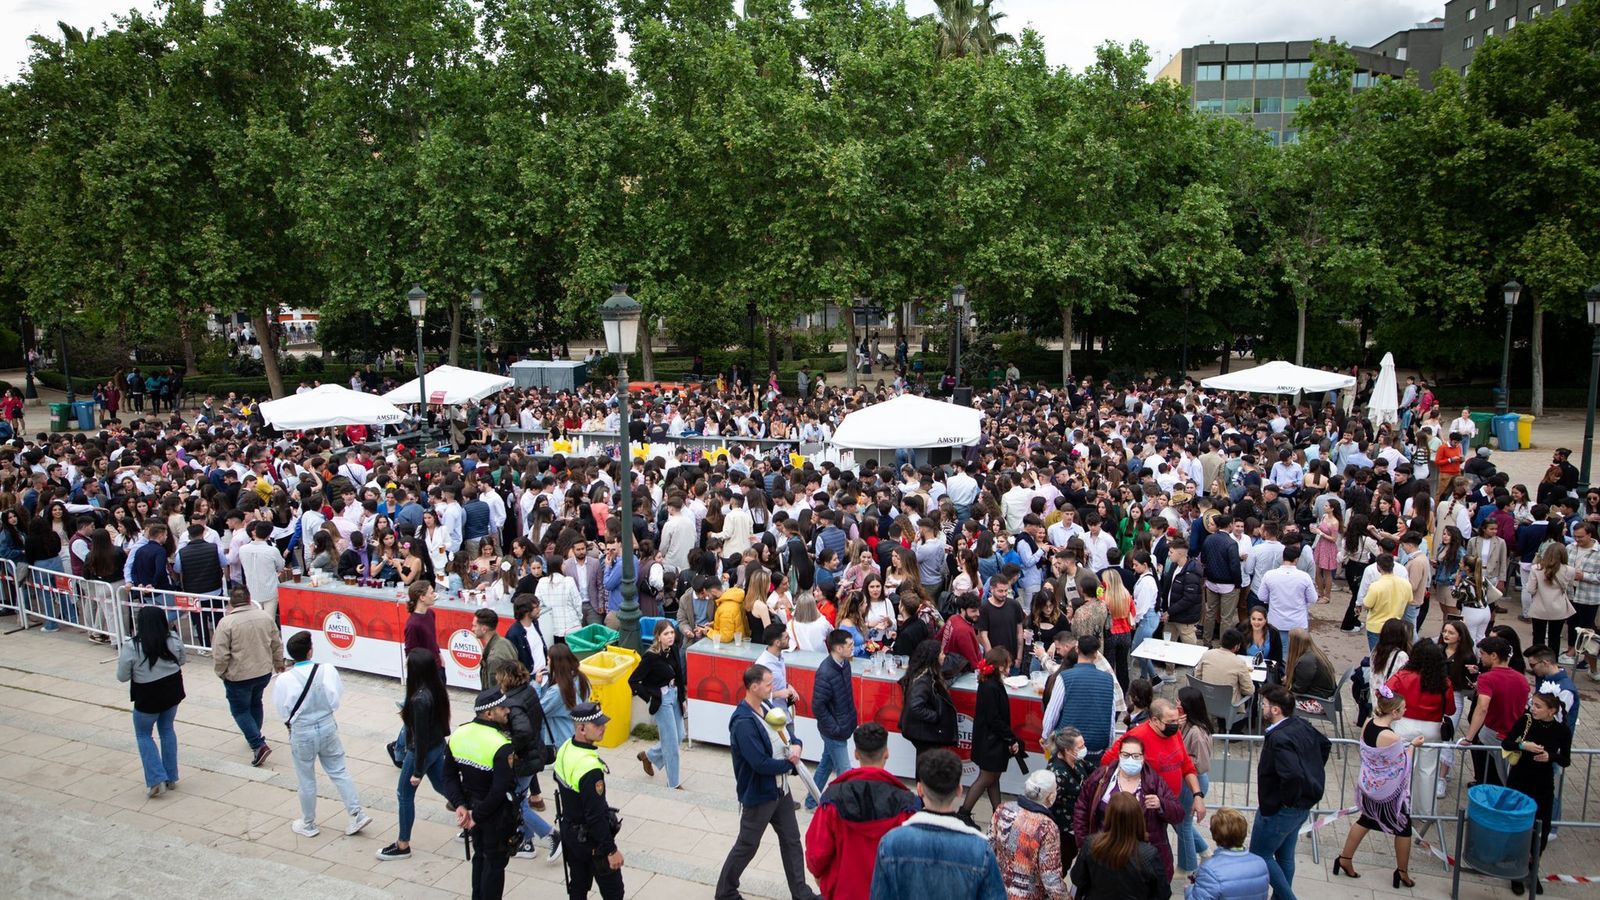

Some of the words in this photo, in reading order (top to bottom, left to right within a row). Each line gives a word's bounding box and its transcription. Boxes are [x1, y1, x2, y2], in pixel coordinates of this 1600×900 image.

[328, 624, 351, 634] AMSTEL
[331, 633, 350, 641] CERVEZA
[454, 642, 479, 652] AMSTEL
[456, 652, 477, 660] CERVEZA
